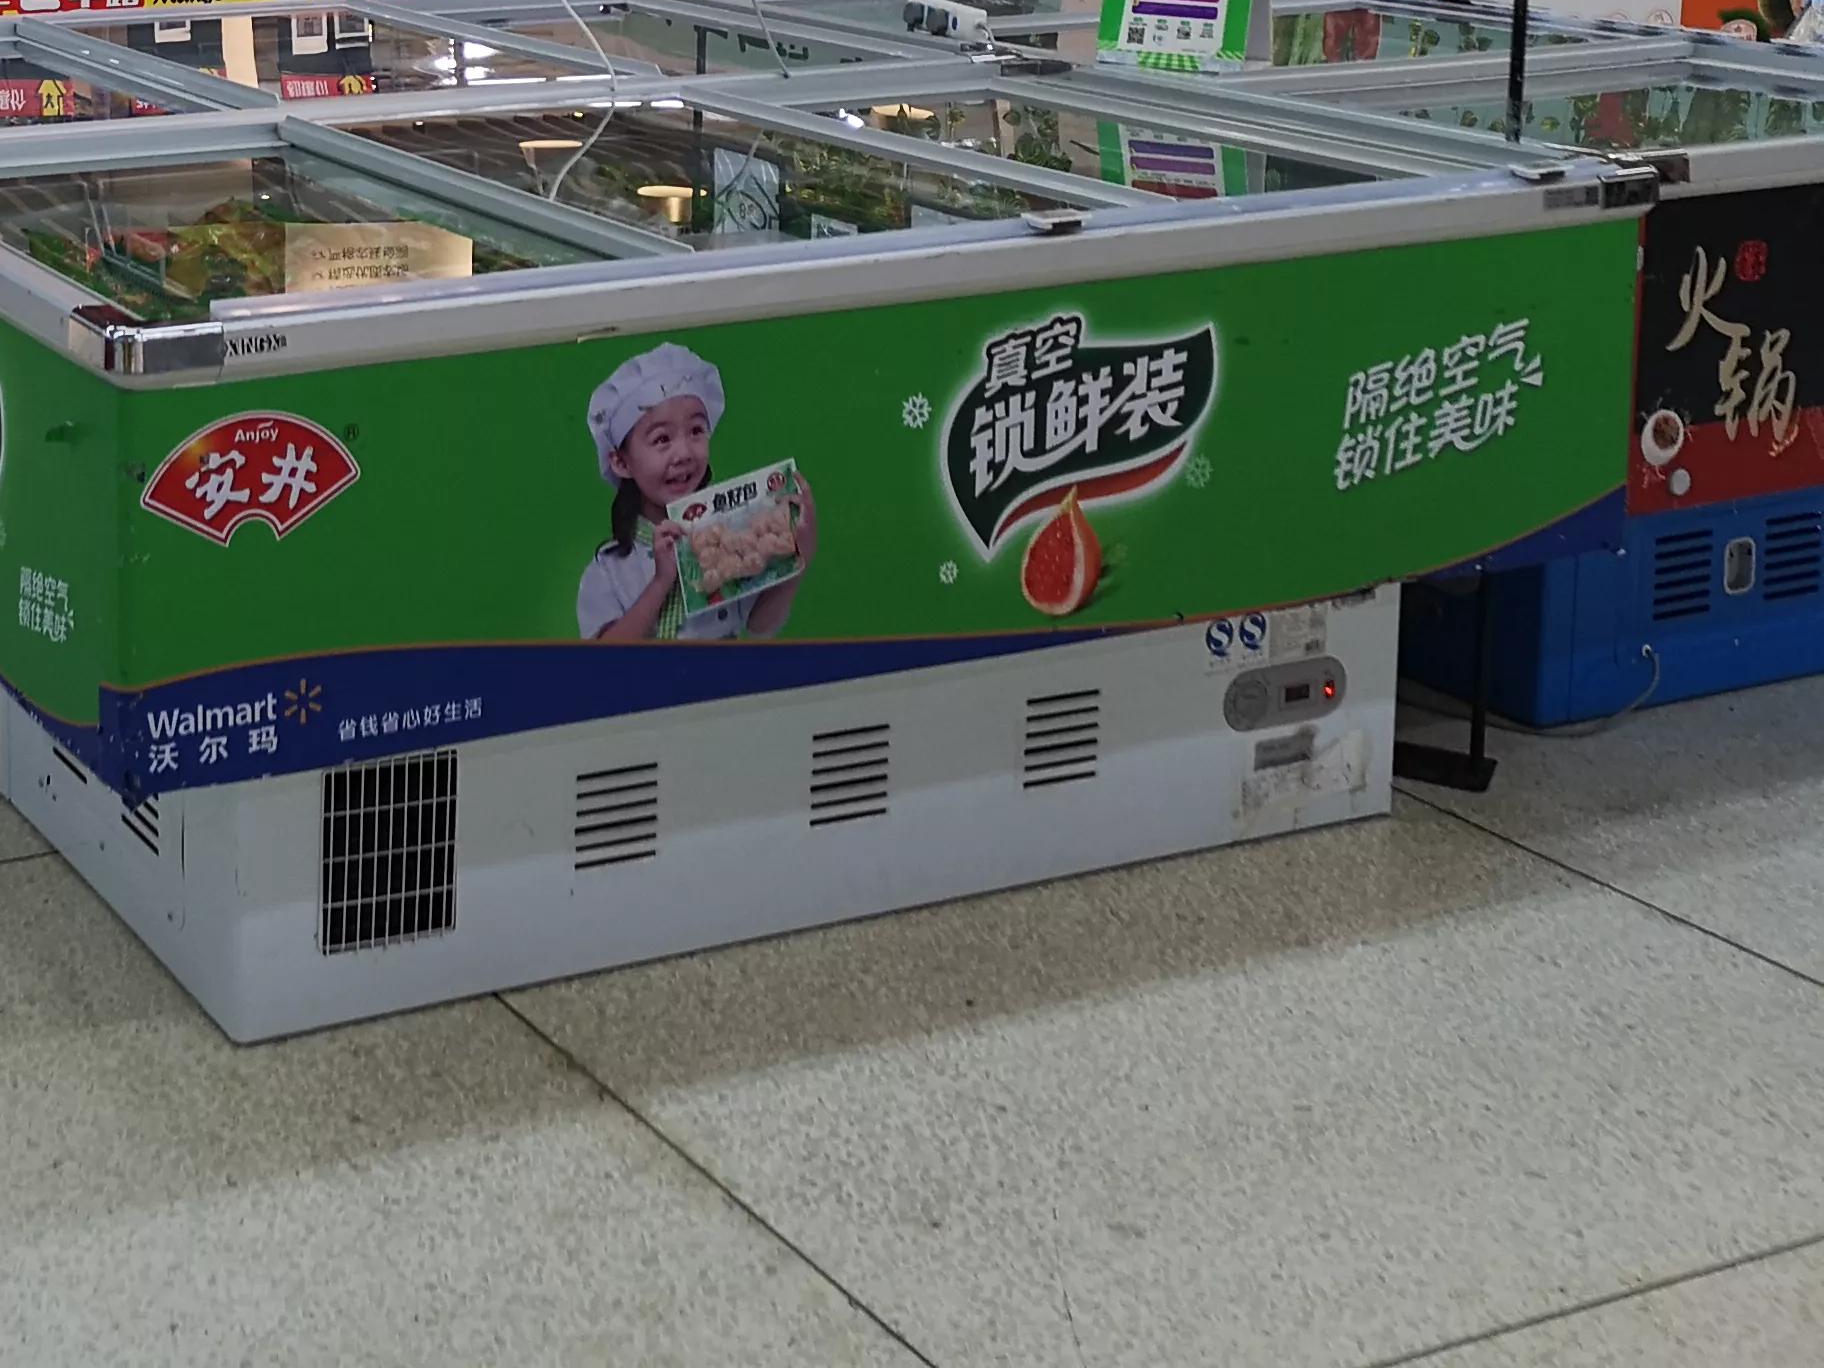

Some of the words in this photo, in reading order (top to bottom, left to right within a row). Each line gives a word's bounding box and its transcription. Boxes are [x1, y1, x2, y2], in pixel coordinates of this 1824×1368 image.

[985, 322, 1079, 391] 真空
[1344, 319, 1529, 426] 隔绝空气
[1665, 245, 1797, 443] 火锅
[234, 422, 279, 444] Anjoy
[970, 348, 1189, 496] 锁鲜装
[1334, 382, 1520, 490] 锁住美味
[185, 443, 319, 520] 安井
[19, 566, 70, 612] 隔绝空气
[17, 598, 68, 643] 锁住美味
[147, 692, 278, 740] Walmart
[338, 697, 483, 743] 省钱省心好生活
[149, 727, 278, 773] 沃尔玛
